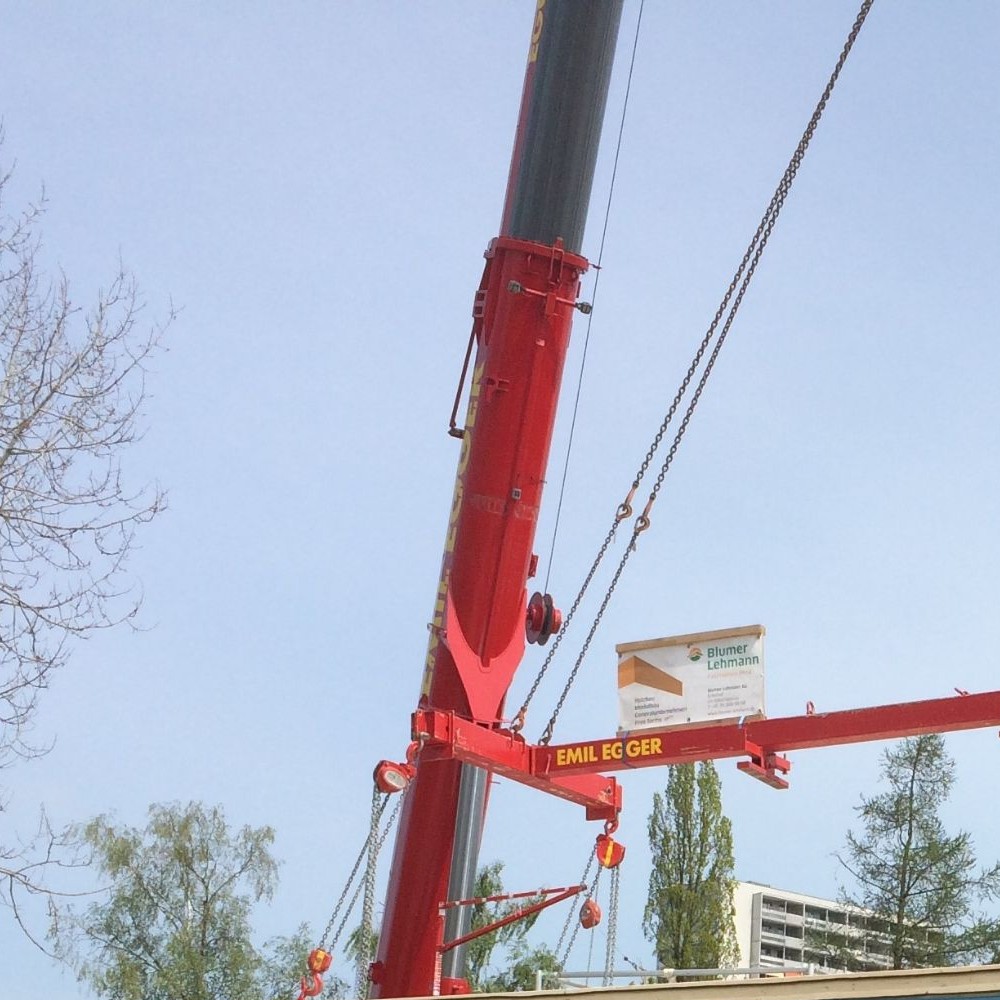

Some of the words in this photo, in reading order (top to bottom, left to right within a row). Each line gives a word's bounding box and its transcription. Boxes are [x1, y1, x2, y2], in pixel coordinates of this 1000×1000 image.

[707, 644, 748, 658] Blumer
[707, 655, 759, 670] Lehmann
[556, 745, 598, 766] EMIL
[602, 737, 663, 761] EGGER
